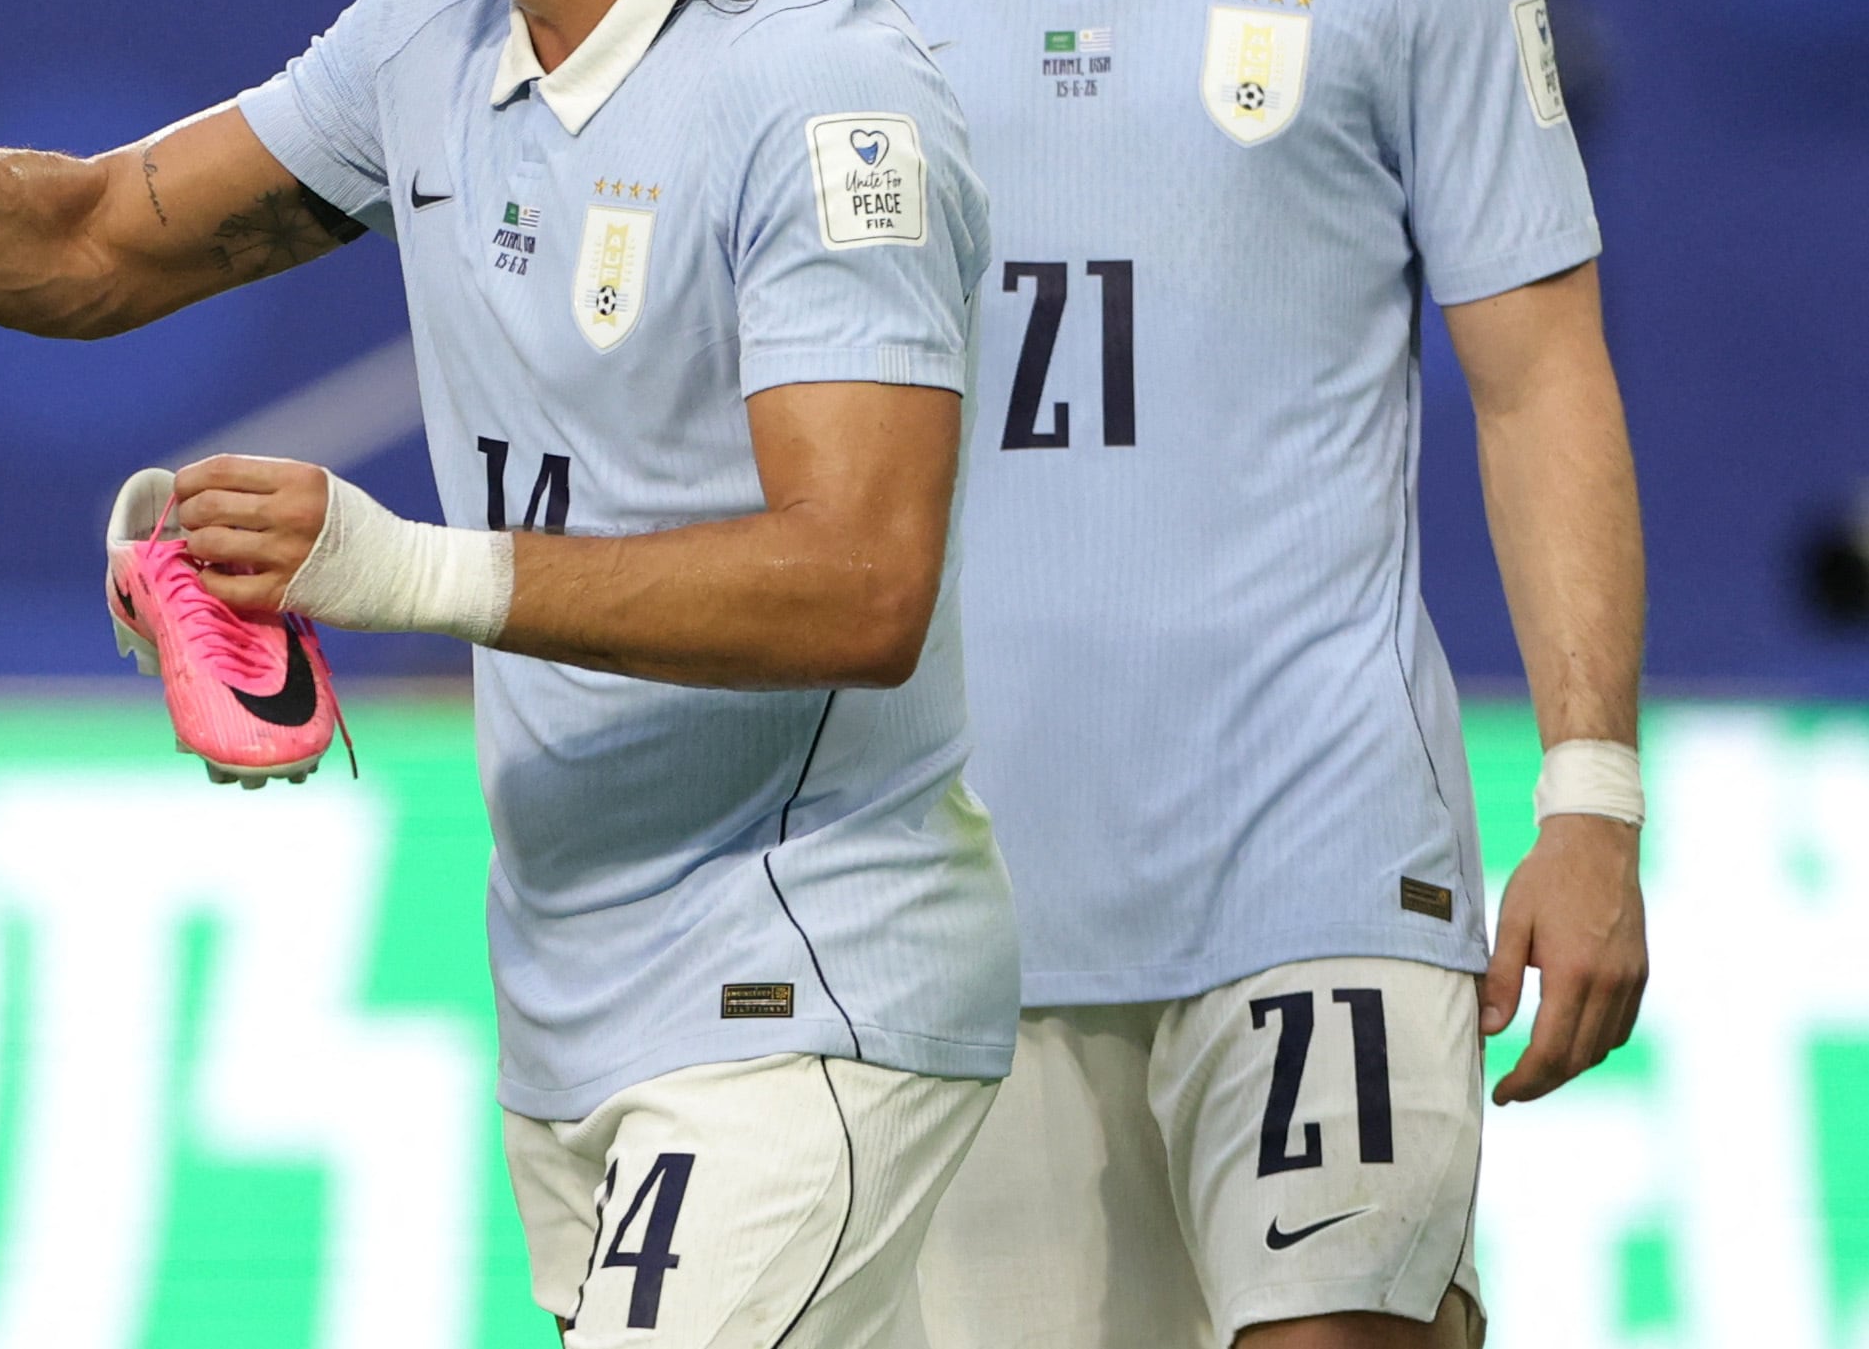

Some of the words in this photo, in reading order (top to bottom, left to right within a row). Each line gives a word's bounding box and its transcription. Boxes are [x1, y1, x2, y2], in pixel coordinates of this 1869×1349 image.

[845, 169, 883, 193] Unite
[882, 168, 902, 190] For
[852, 193, 902, 216] PEACE
[866, 218, 894, 229] FIFA
[1000, 259, 1136, 450] 21
[1249, 988, 1394, 1179] 21
